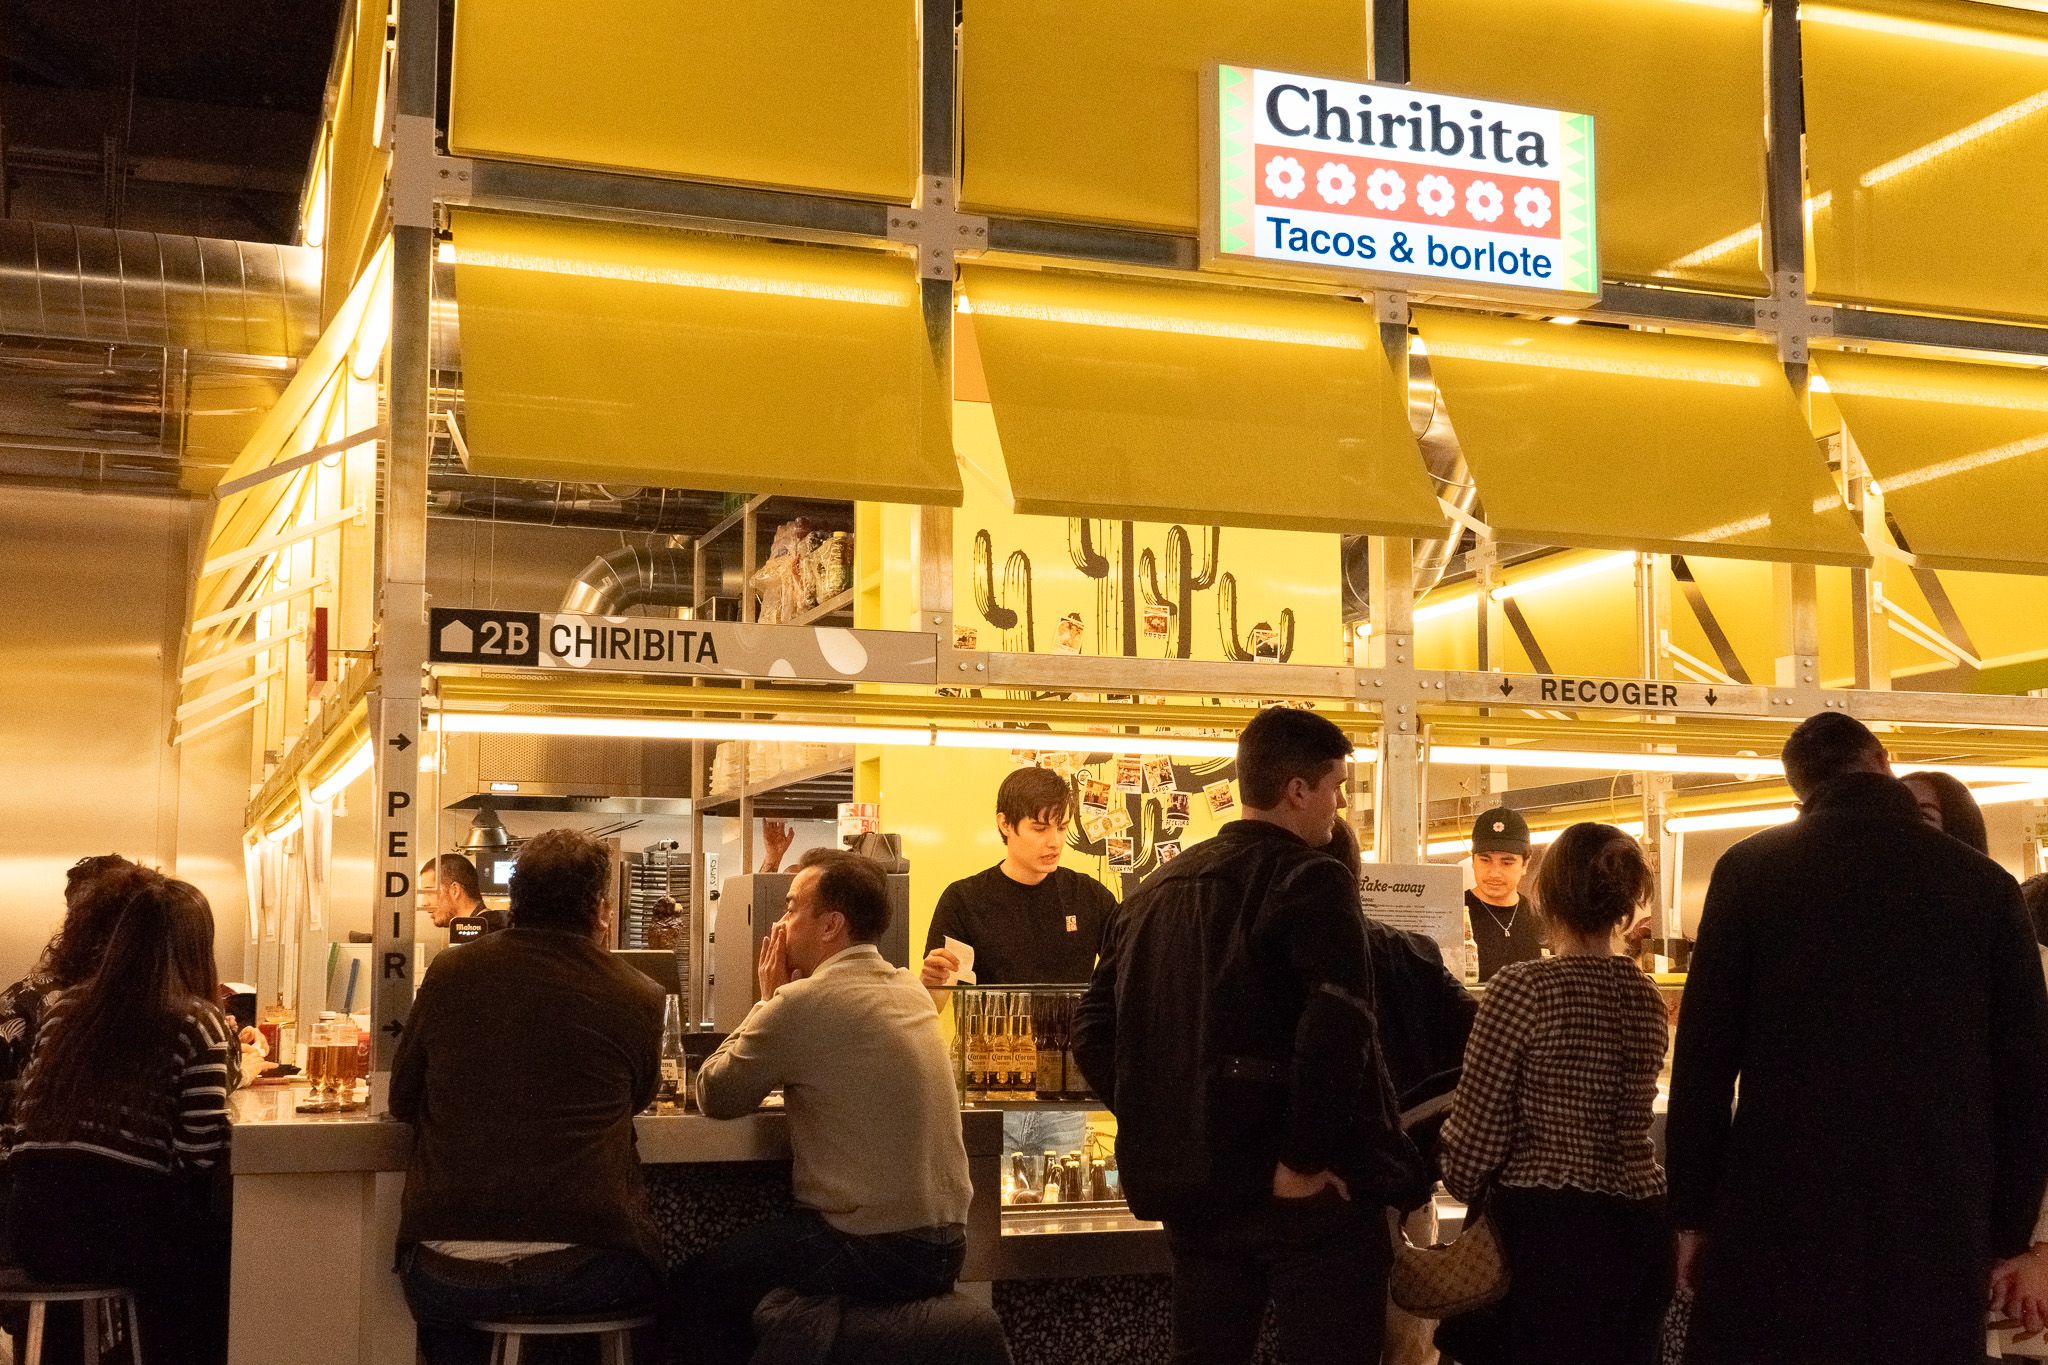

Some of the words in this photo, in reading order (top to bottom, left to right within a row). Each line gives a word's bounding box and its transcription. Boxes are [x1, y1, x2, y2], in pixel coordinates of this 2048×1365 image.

[1266, 84, 1549, 168] Chiribita
[1266, 216, 1377, 260] Tacos
[1389, 231, 1415, 264] &
[1427, 234, 1553, 279] borlote
[480, 620, 530, 656] 2B
[549, 624, 719, 664] CHIRIBITA
[1541, 678, 1678, 707] RECOGER
[384, 791, 411, 980] PEDIR
[1359, 875, 1426, 898] Take-away
